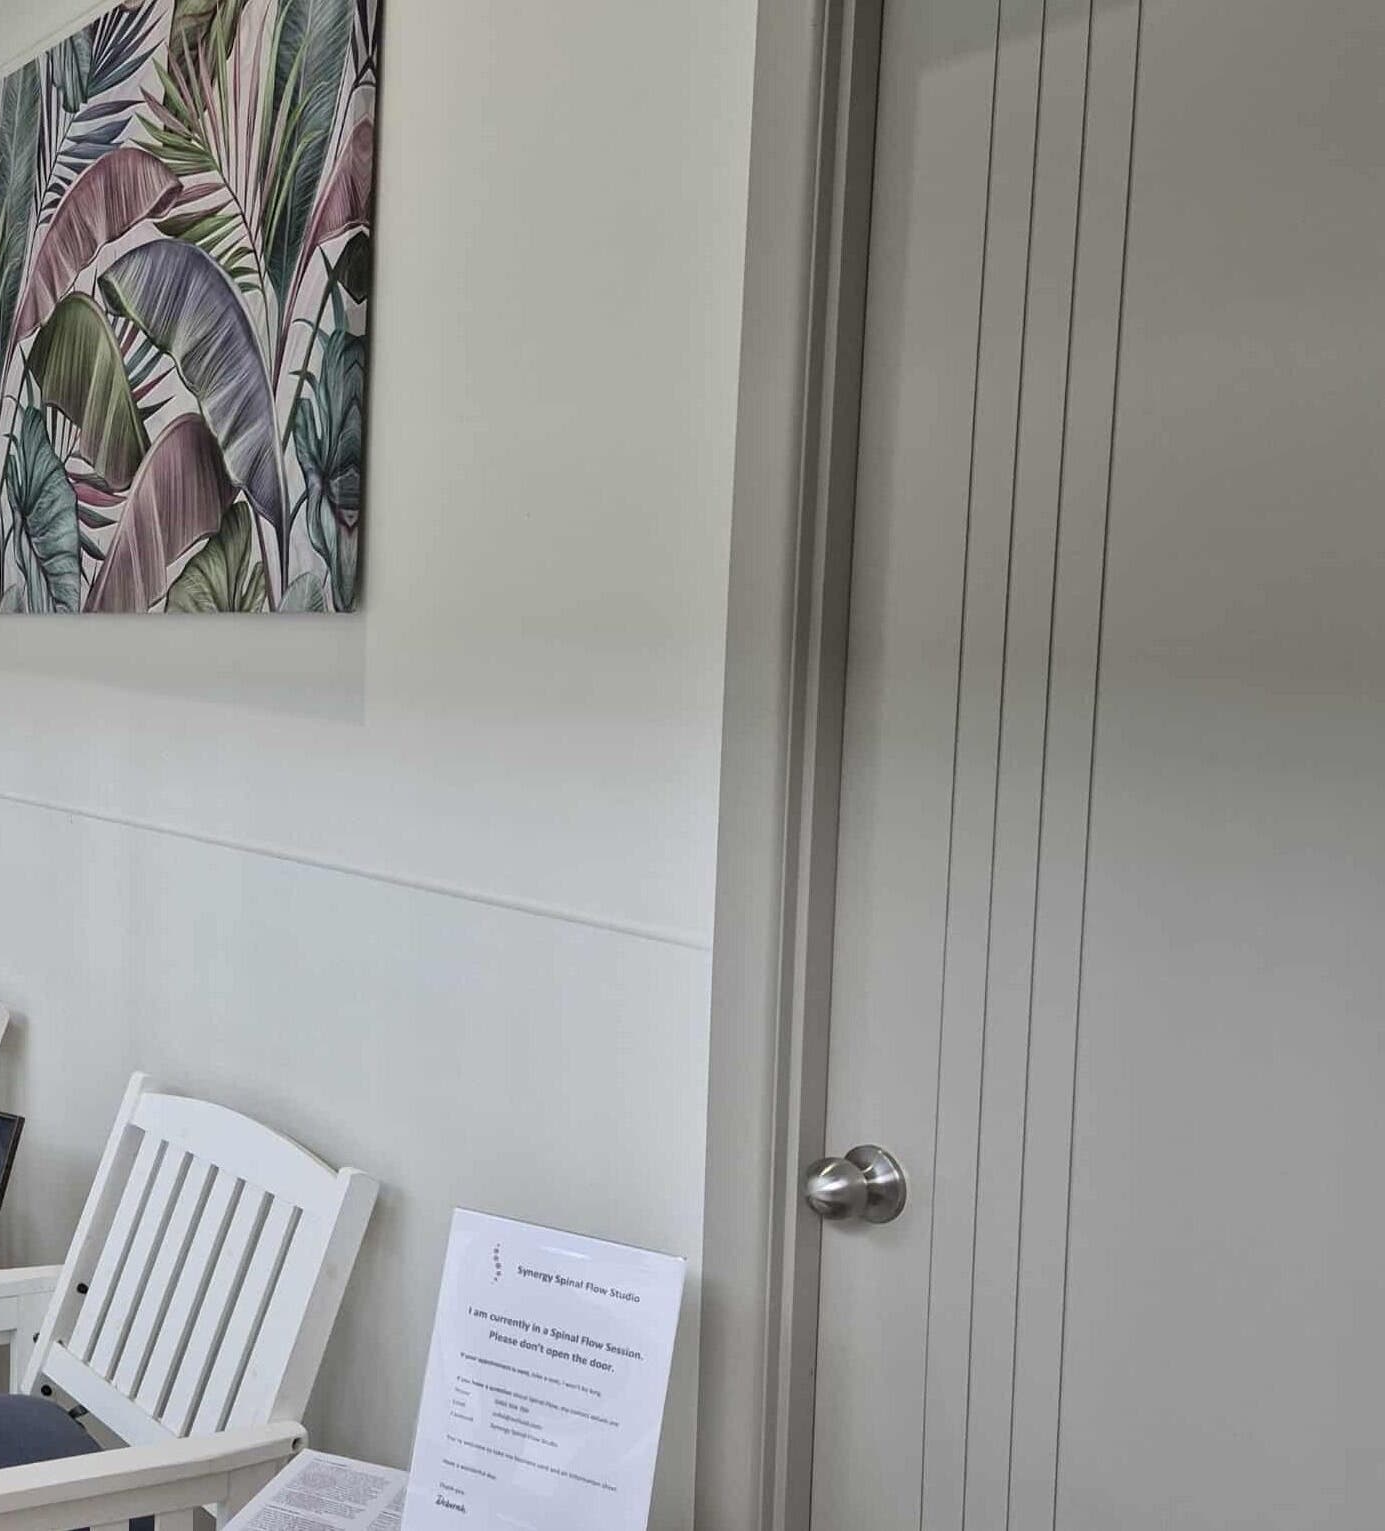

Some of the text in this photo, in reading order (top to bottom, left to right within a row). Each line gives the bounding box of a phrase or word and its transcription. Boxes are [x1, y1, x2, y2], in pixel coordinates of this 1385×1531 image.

[517, 1264, 641, 1303] Synergy Spinal Flow Studio
[473, 1308, 488, 1319] am
[489, 1313, 531, 1332] currently
[532, 1322, 541, 1333] in
[542, 1327, 549, 1335] a
[549, 1327, 579, 1344] Spinal
[580, 1335, 604, 1350] Flow
[605, 1342, 644, 1361] Session.
[488, 1329, 615, 1373] Please don't open the door.
